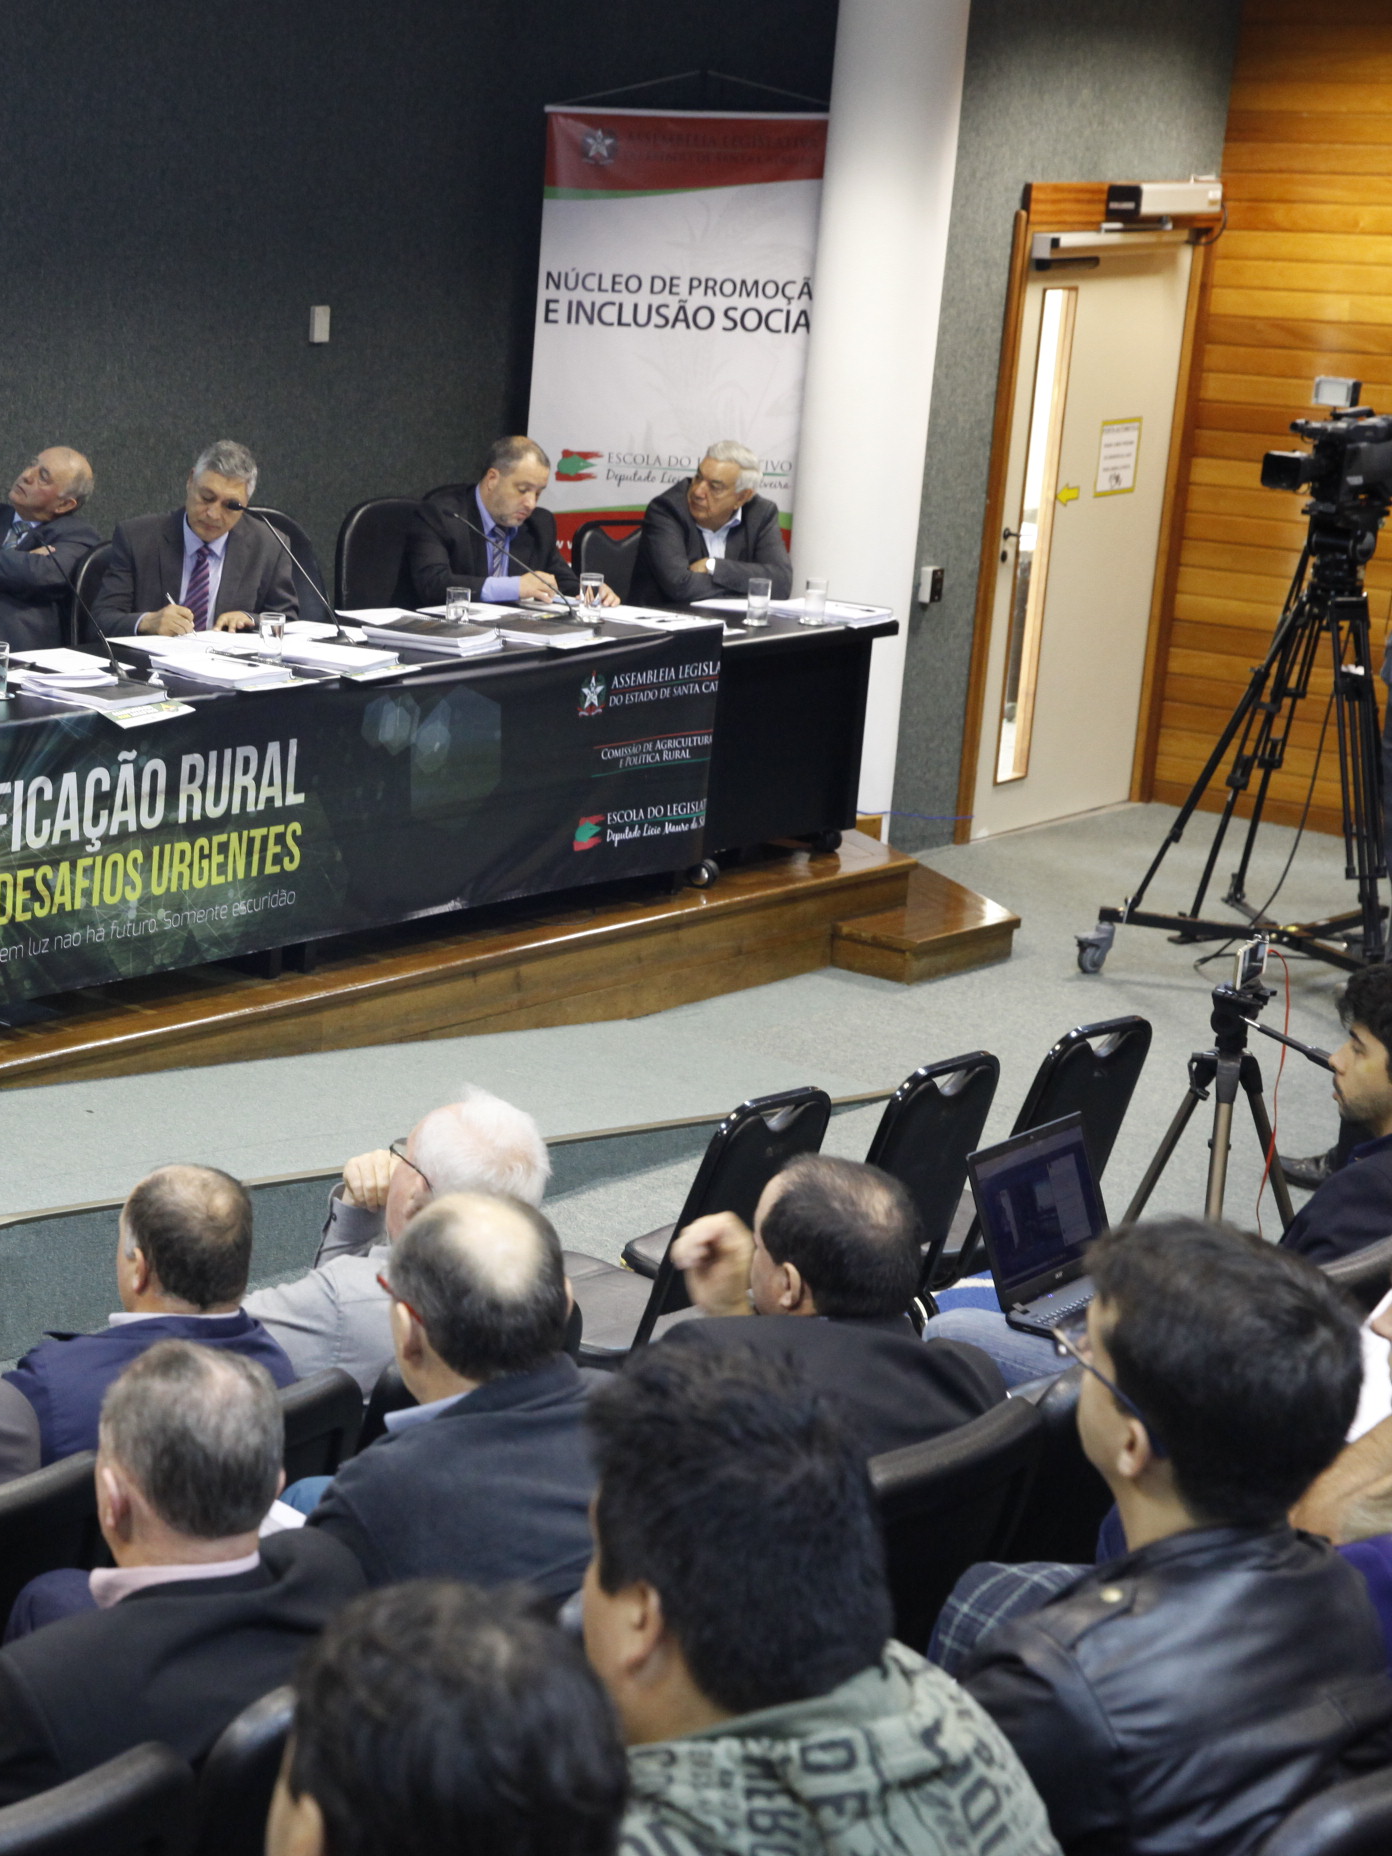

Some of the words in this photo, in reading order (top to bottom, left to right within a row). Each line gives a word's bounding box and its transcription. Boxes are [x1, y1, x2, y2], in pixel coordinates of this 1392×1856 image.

[545, 267, 643, 294] NÚCLEO
[650, 275, 681, 296] DE
[544, 298, 560, 324] E
[566, 298, 715, 331] INCLUSÃO
[607, 452, 662, 467] ESCOLA
[667, 454, 691, 468] DO
[611, 667, 676, 690] ASSEMBLEIA
[609, 694, 623, 708] DO
[625, 689, 658, 704] ESTADO
[659, 687, 671, 699] DE
[672, 682, 700, 698] SANTA
[662, 748, 691, 762] RURAL
[178, 738, 306, 825] RURAL
[607, 808, 645, 825] ESCOLA
[647, 804, 664, 819] DO
[606, 824, 641, 848] Deputado
[151, 821, 303, 897] URGENTES
[28, 936, 50, 956] luz
[163, 904, 228, 930] Somente
[232, 889, 296, 917] escuridão
